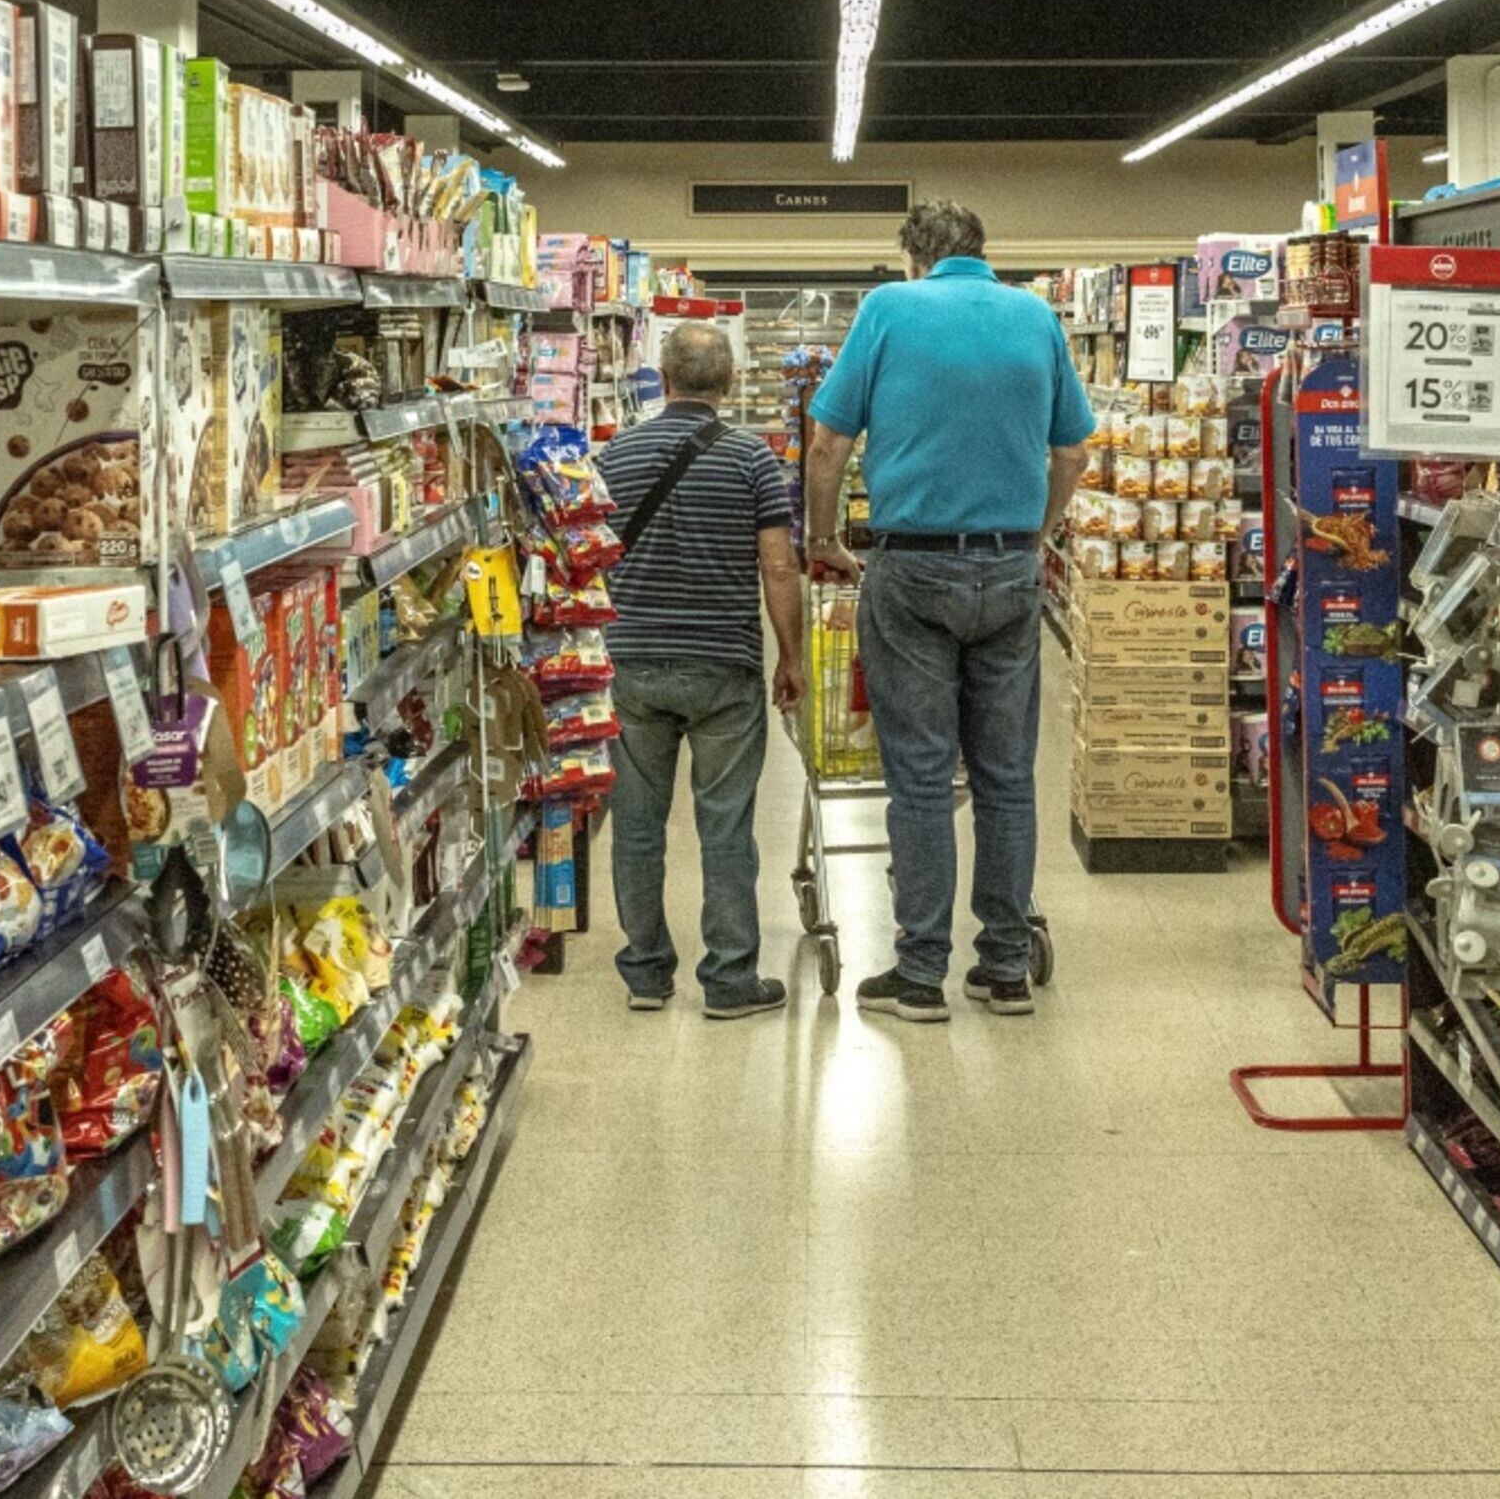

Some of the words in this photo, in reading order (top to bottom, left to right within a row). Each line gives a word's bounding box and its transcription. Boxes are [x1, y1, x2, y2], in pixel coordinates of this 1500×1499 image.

[775, 193, 828, 207] CARNES
[1228, 255, 1268, 273] Elite
[1245, 330, 1287, 349] Elite
[1238, 424, 1261, 442] Eli
[100, 539, 127, 553] 220
